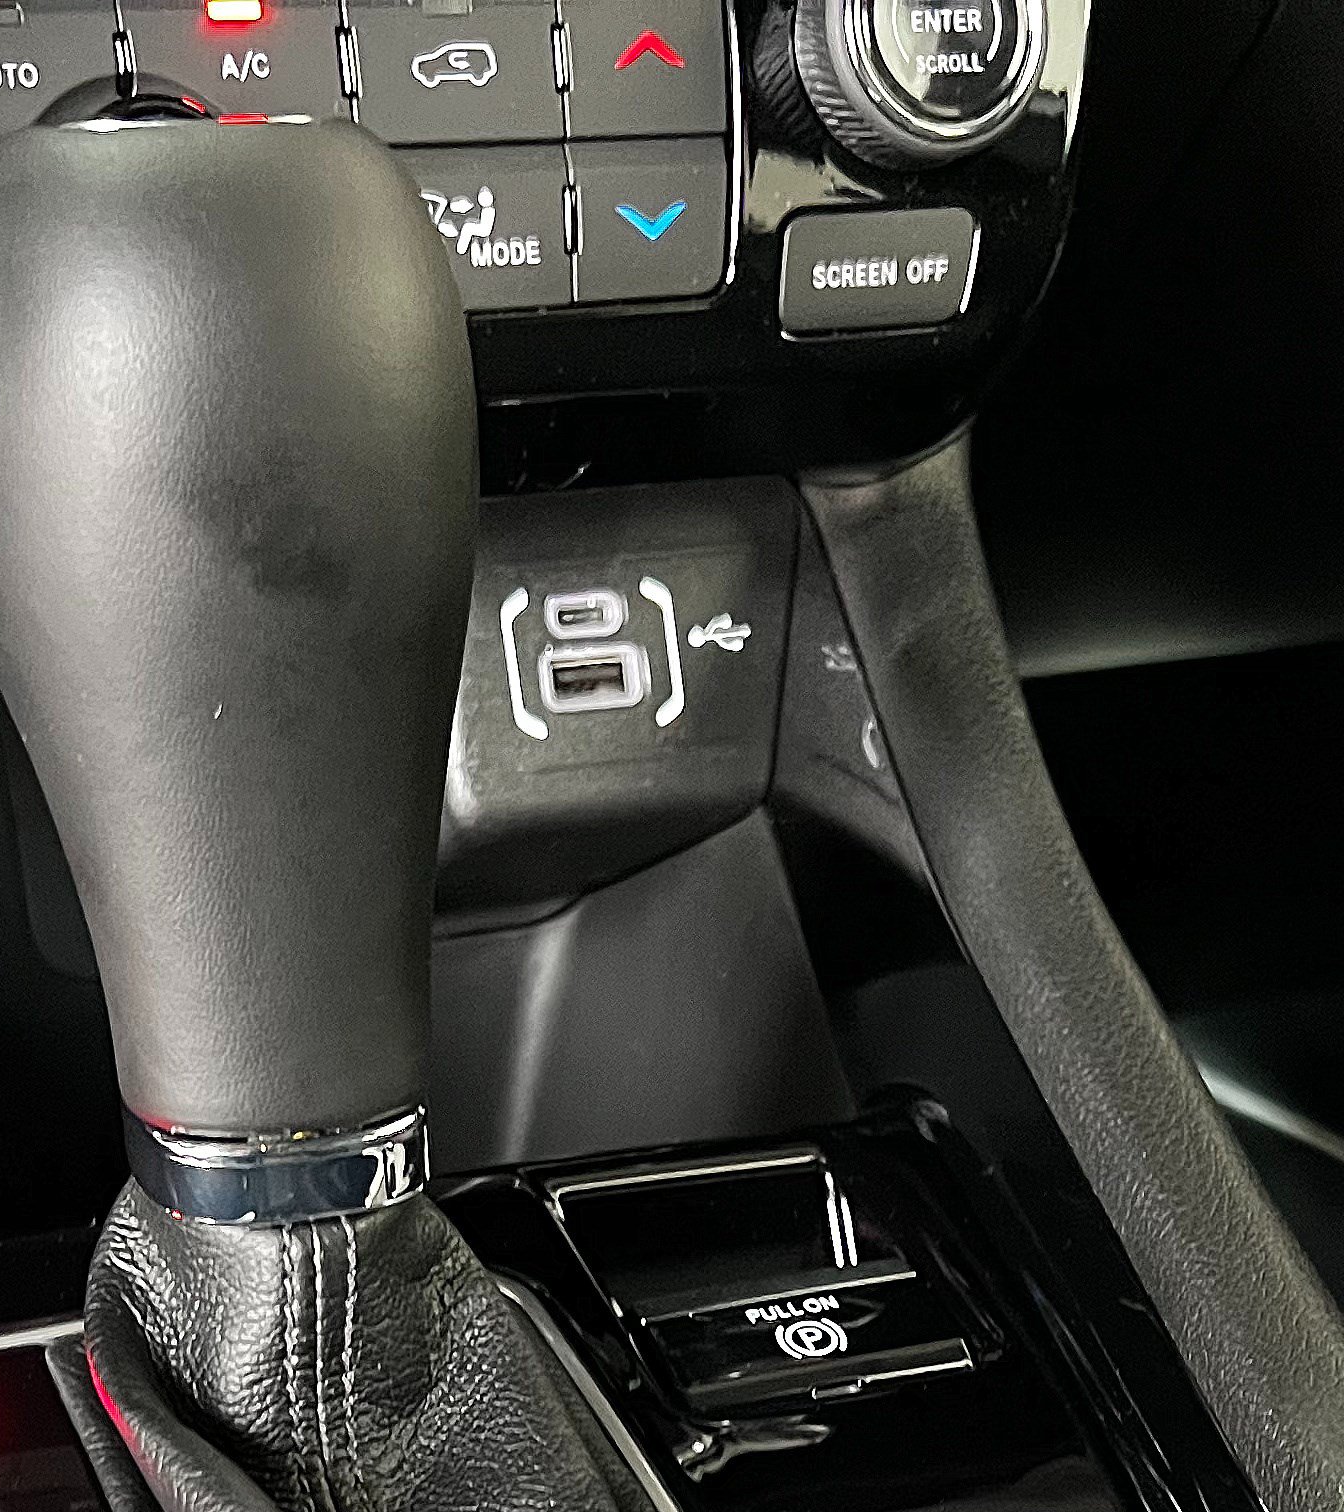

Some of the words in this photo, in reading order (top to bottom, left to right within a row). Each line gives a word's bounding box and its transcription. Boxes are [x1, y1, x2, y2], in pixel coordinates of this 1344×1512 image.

[911, 9, 982, 33] ENTER
[221, 49, 271, 82] A/C
[916, 53, 985, 74] SCROLL
[470, 235, 542, 267] MODE
[812, 257, 898, 289] SCREEN
[906, 253, 949, 284] OFF
[745, 1302, 805, 1324] PULL
[803, 1295, 840, 1313] ON
